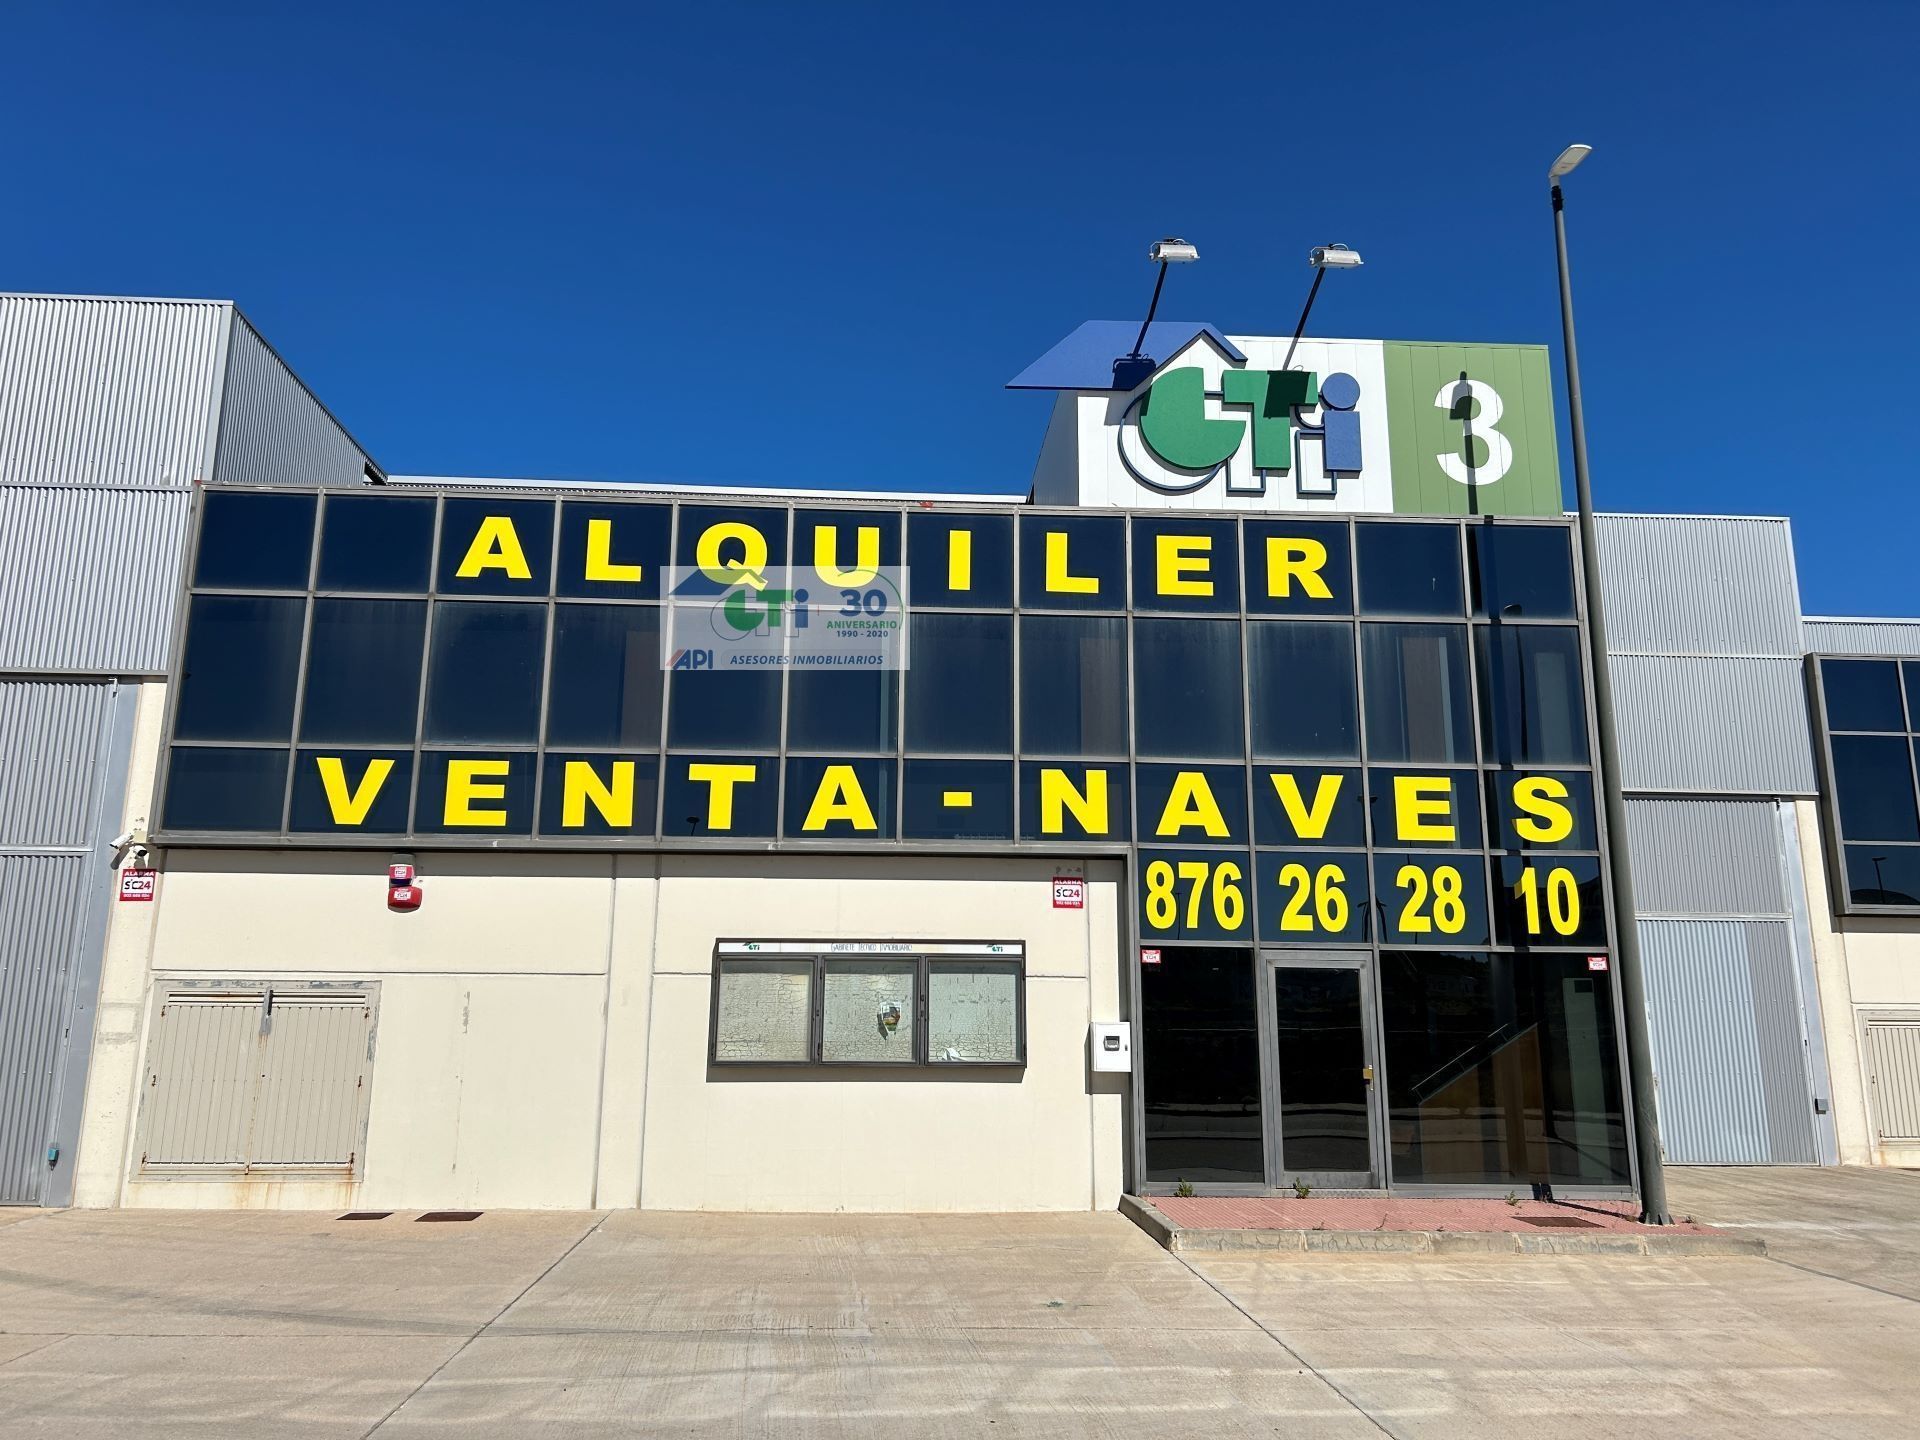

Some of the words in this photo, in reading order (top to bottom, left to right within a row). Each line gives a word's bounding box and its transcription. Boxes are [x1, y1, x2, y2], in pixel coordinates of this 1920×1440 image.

[1434, 379, 1513, 486] 3
[456, 515, 1334, 599] ALQUILER
[1145, 860, 1246, 932] 876
[1278, 862, 1349, 933] 26
[1395, 864, 1466, 935] 28
[1513, 866, 1582, 936] 10
